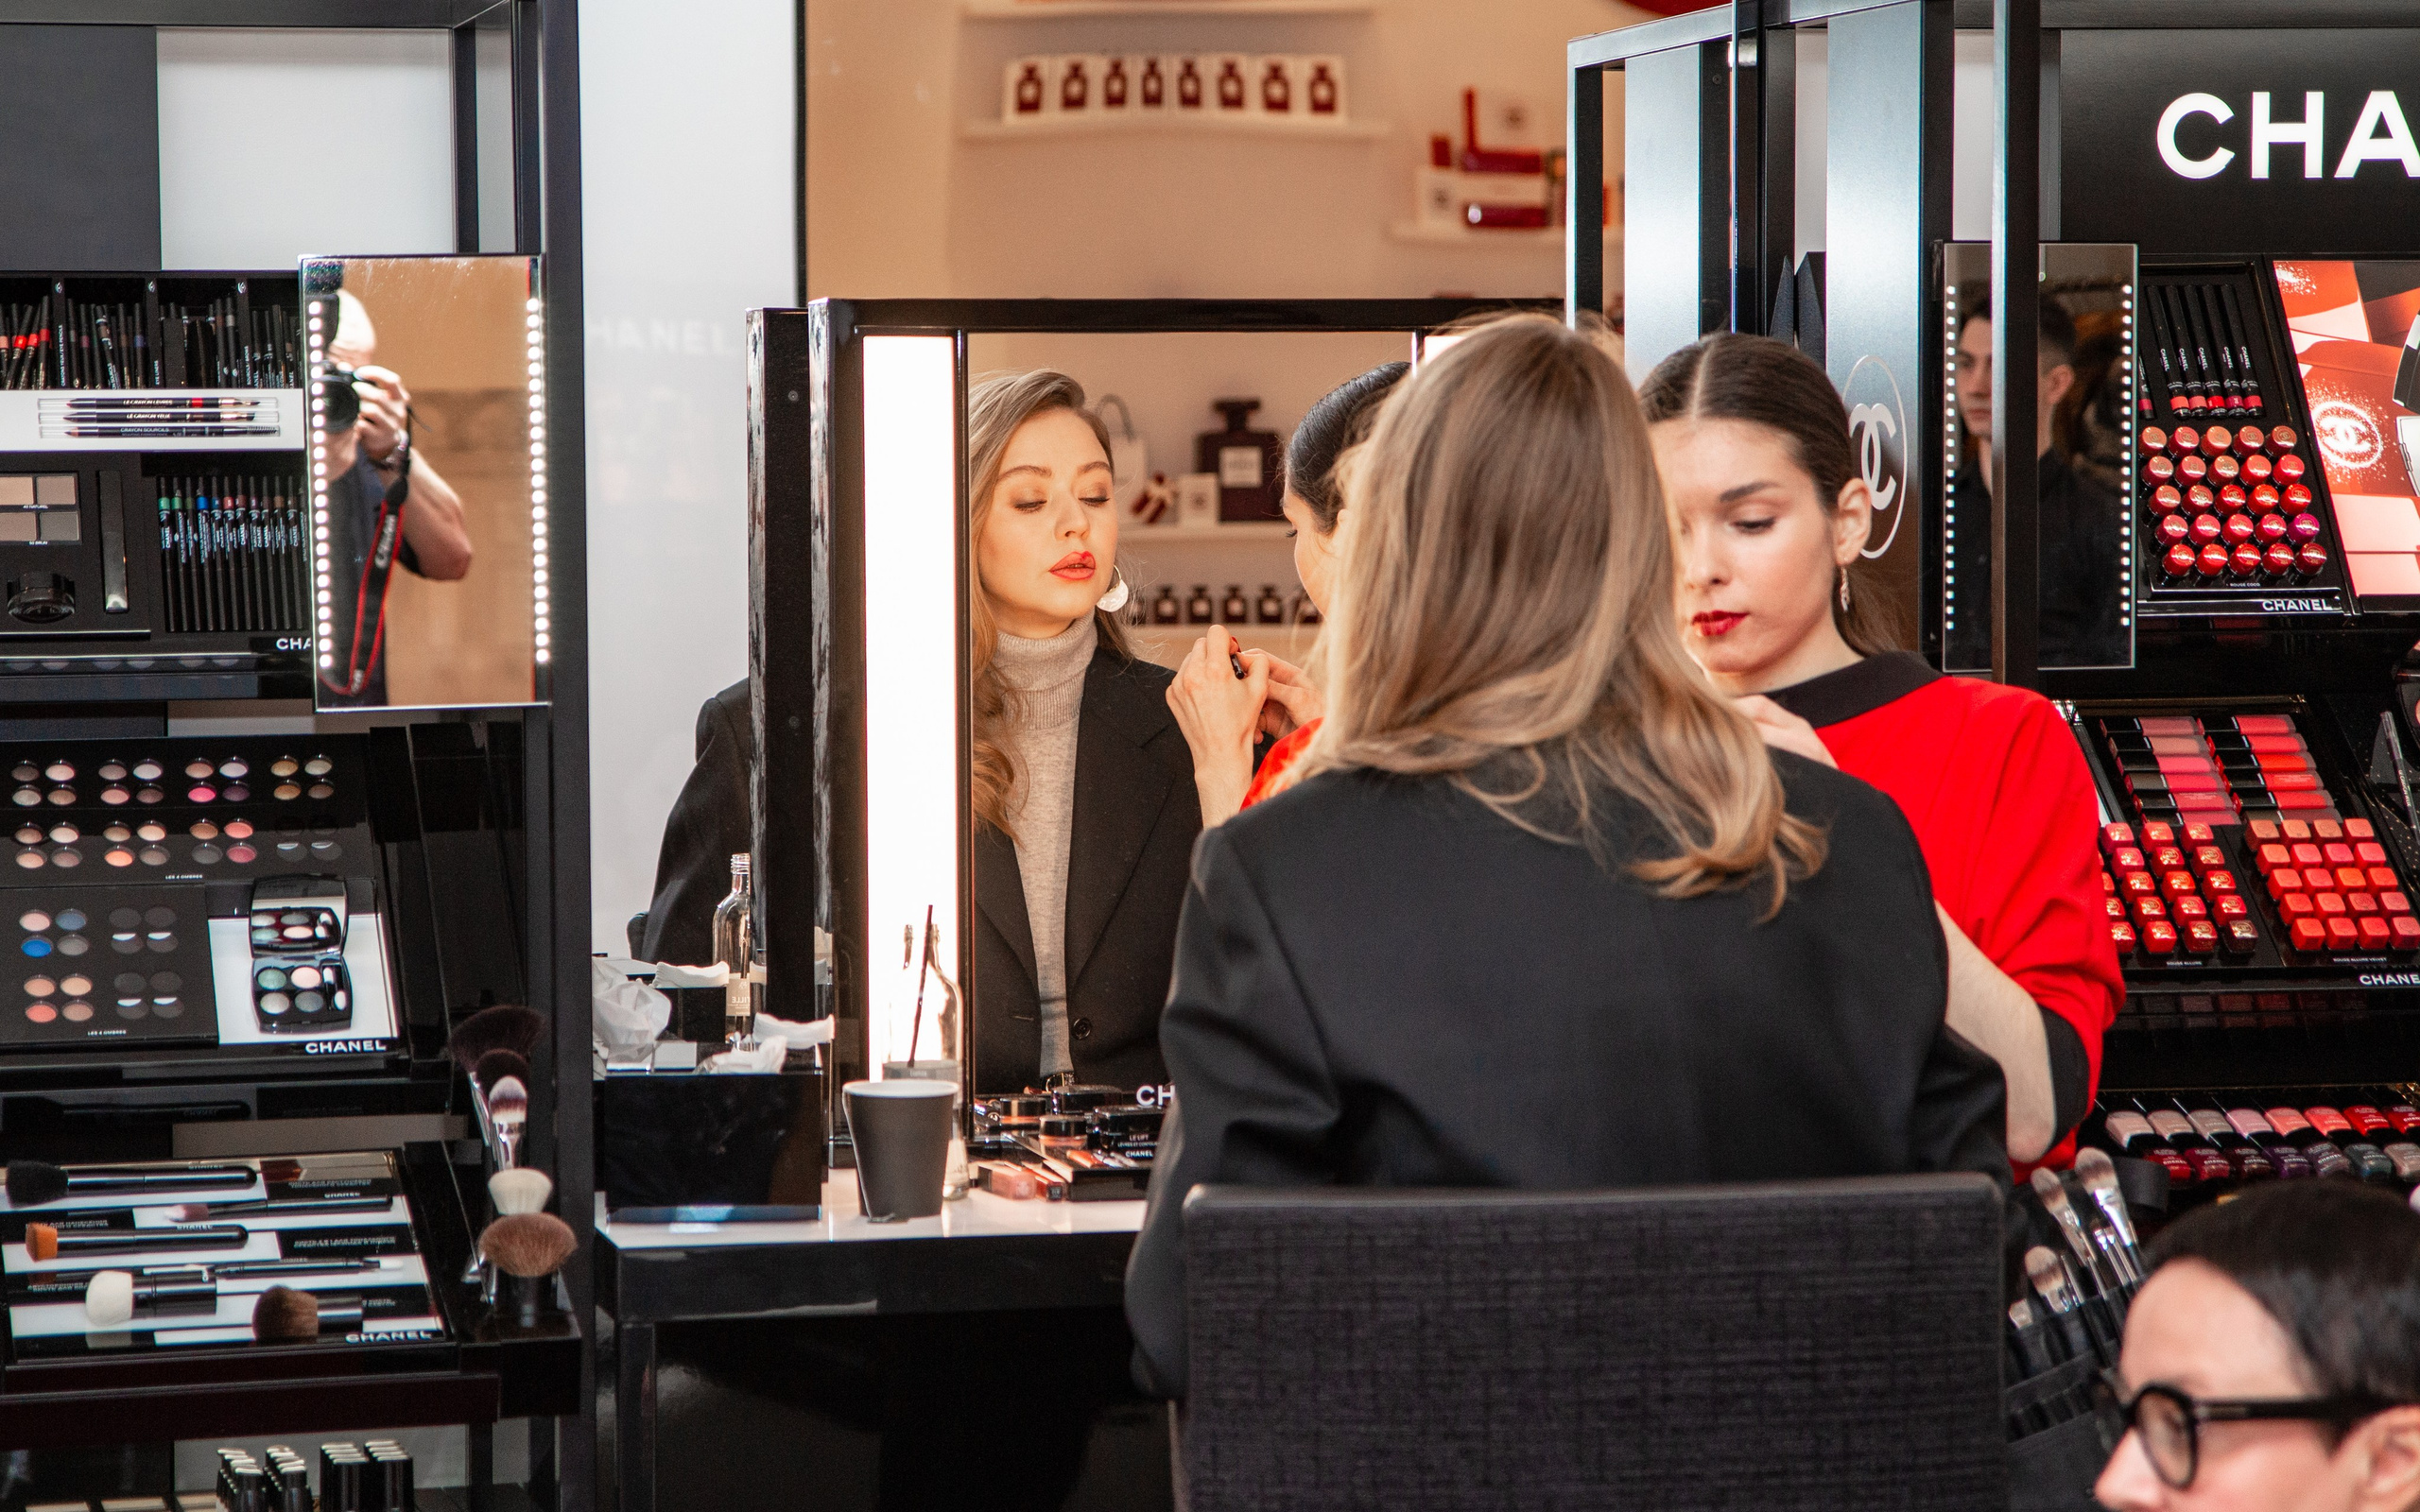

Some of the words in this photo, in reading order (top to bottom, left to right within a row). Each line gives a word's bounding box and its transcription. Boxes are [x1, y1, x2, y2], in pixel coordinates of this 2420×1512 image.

[2156, 91, 2420, 180] CHA
[2160, 348, 2169, 371] CHANEL
[2179, 348, 2188, 371] CHANEL
[2199, 347, 2208, 370] CHANEL
[2223, 346, 2233, 369] CHANEL
[2241, 346, 2251, 369] CHANEL
[2262, 598, 2333, 611] CHANEL
[276, 637, 311, 650] CHA
[2360, 973, 2420, 986] CHANE
[305, 1040, 387, 1055] CHANEL
[1136, 1085, 1175, 1107] CH
[345, 1331, 432, 1344] CHANEL
